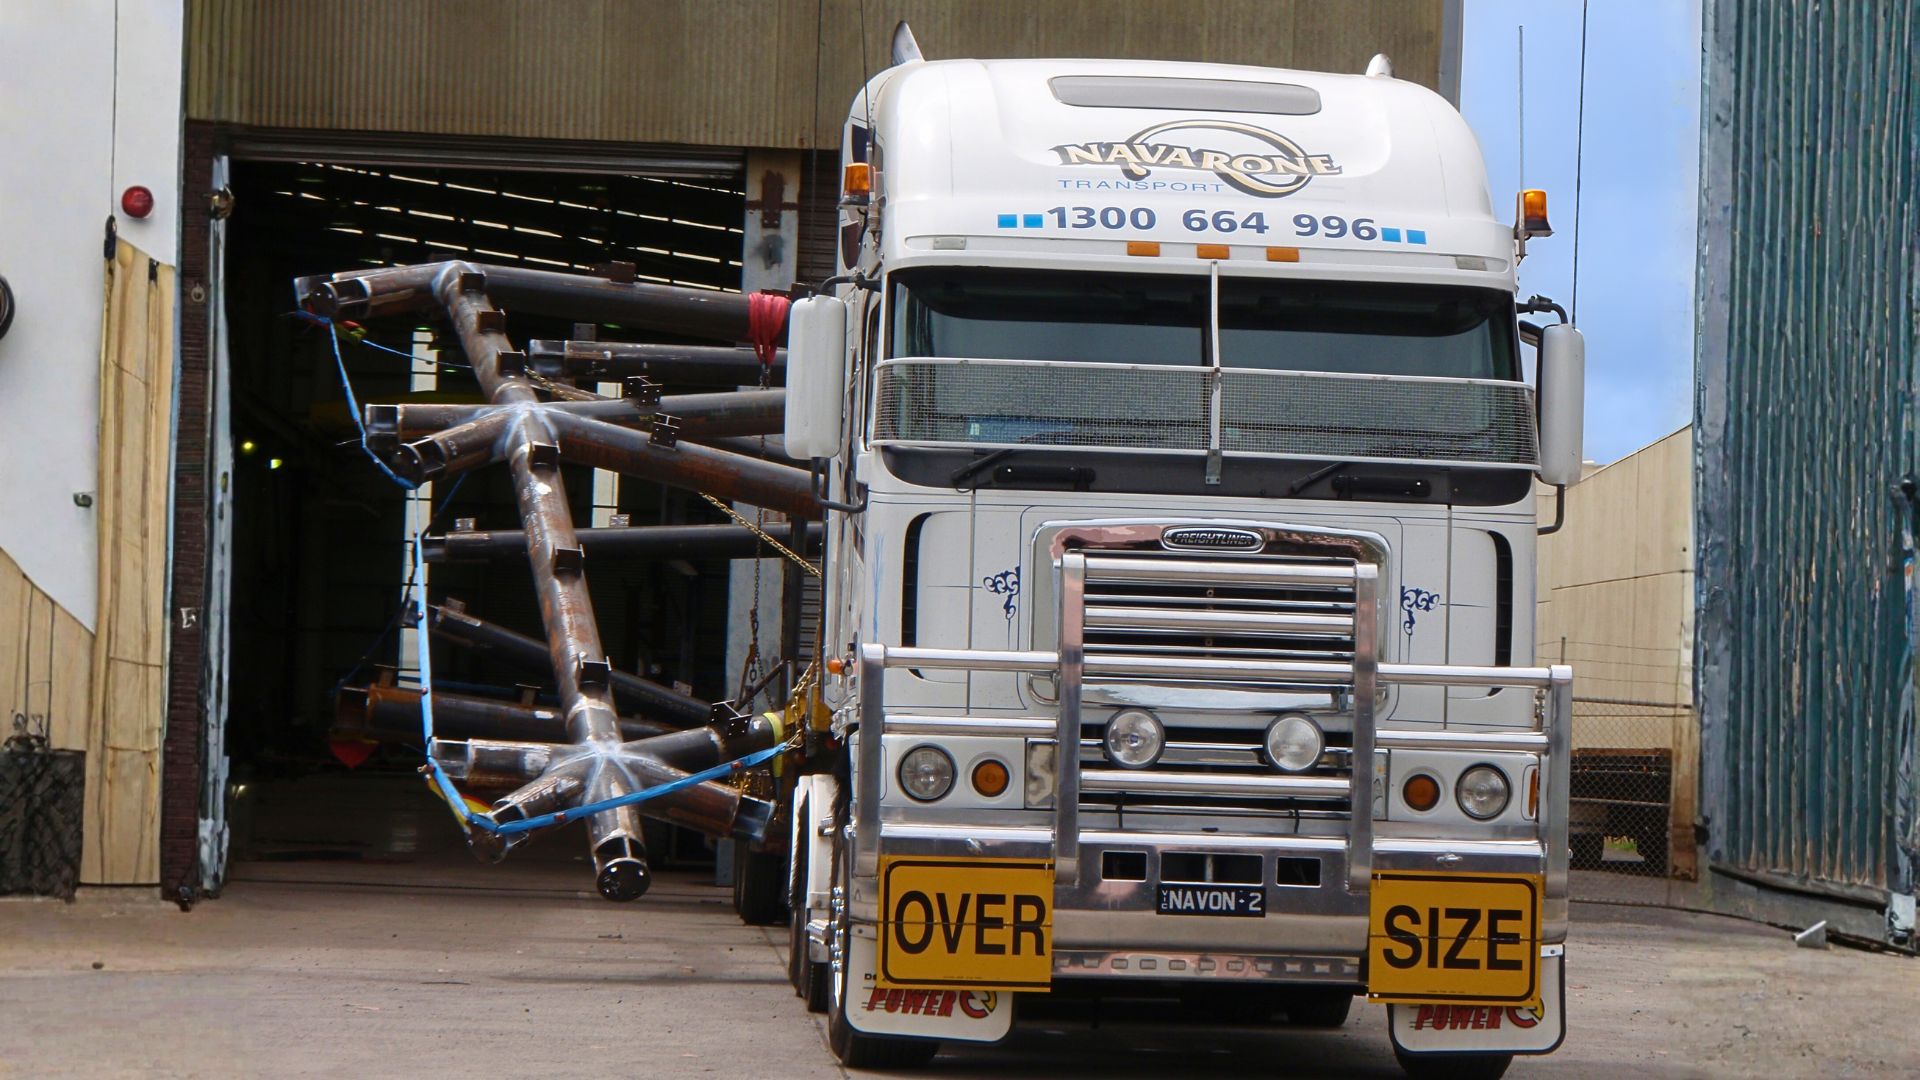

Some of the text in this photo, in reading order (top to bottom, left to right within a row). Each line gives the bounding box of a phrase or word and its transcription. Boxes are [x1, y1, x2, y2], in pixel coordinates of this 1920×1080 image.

[1050, 141, 1343, 176] NAVARONE
[1058, 179, 1225, 193] TRANSPORT
[1047, 206, 1377, 241] 1300 664 996
[1175, 533, 1253, 545] FREIGHTLINER
[895, 890, 1046, 956] OVER
[1383, 905, 1523, 971] SIZE
[866, 988, 957, 1018] POWER
[1414, 1004, 1504, 1031] POWER
